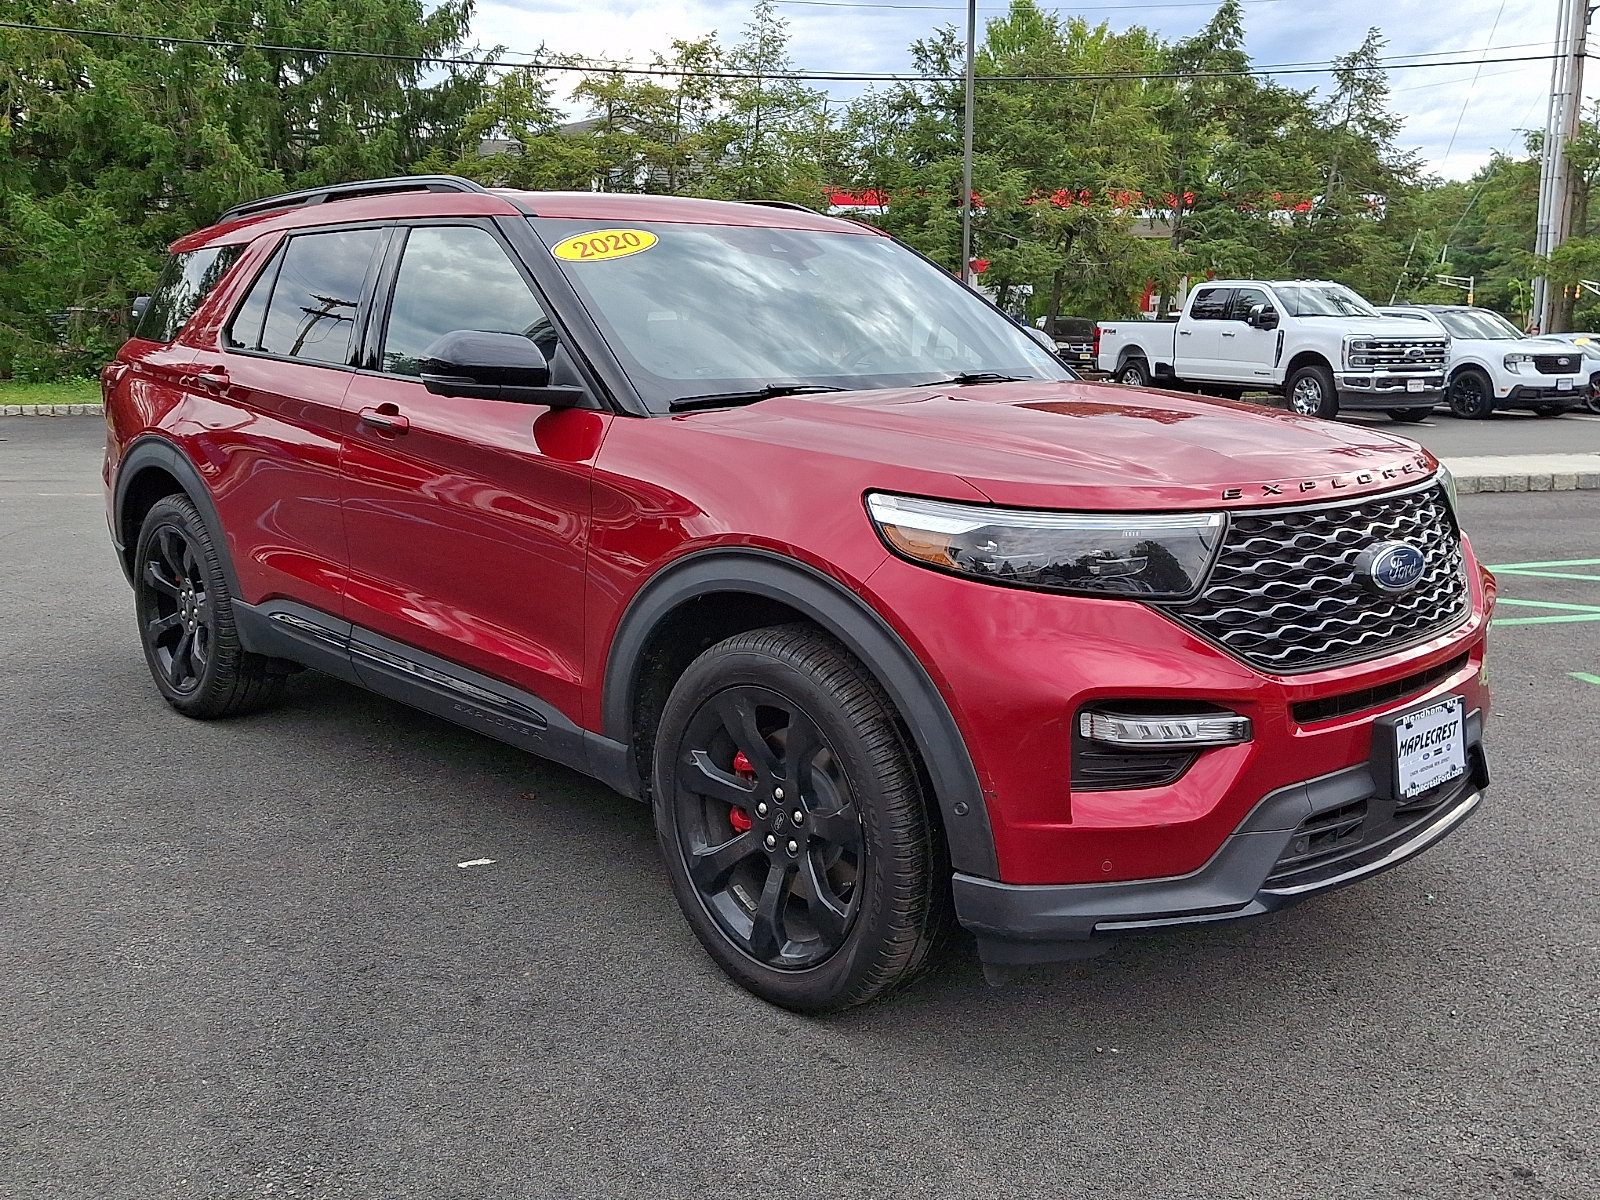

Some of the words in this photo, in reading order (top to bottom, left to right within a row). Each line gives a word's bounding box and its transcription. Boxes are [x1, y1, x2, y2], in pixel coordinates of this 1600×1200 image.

[573, 232, 641, 258] 2020
[1221, 456, 1431, 501] EXPLORER
[1388, 553, 1417, 582] Ford
[1446, 698, 1458, 708] NJ
[1399, 720, 1459, 758] MAPLECREST
